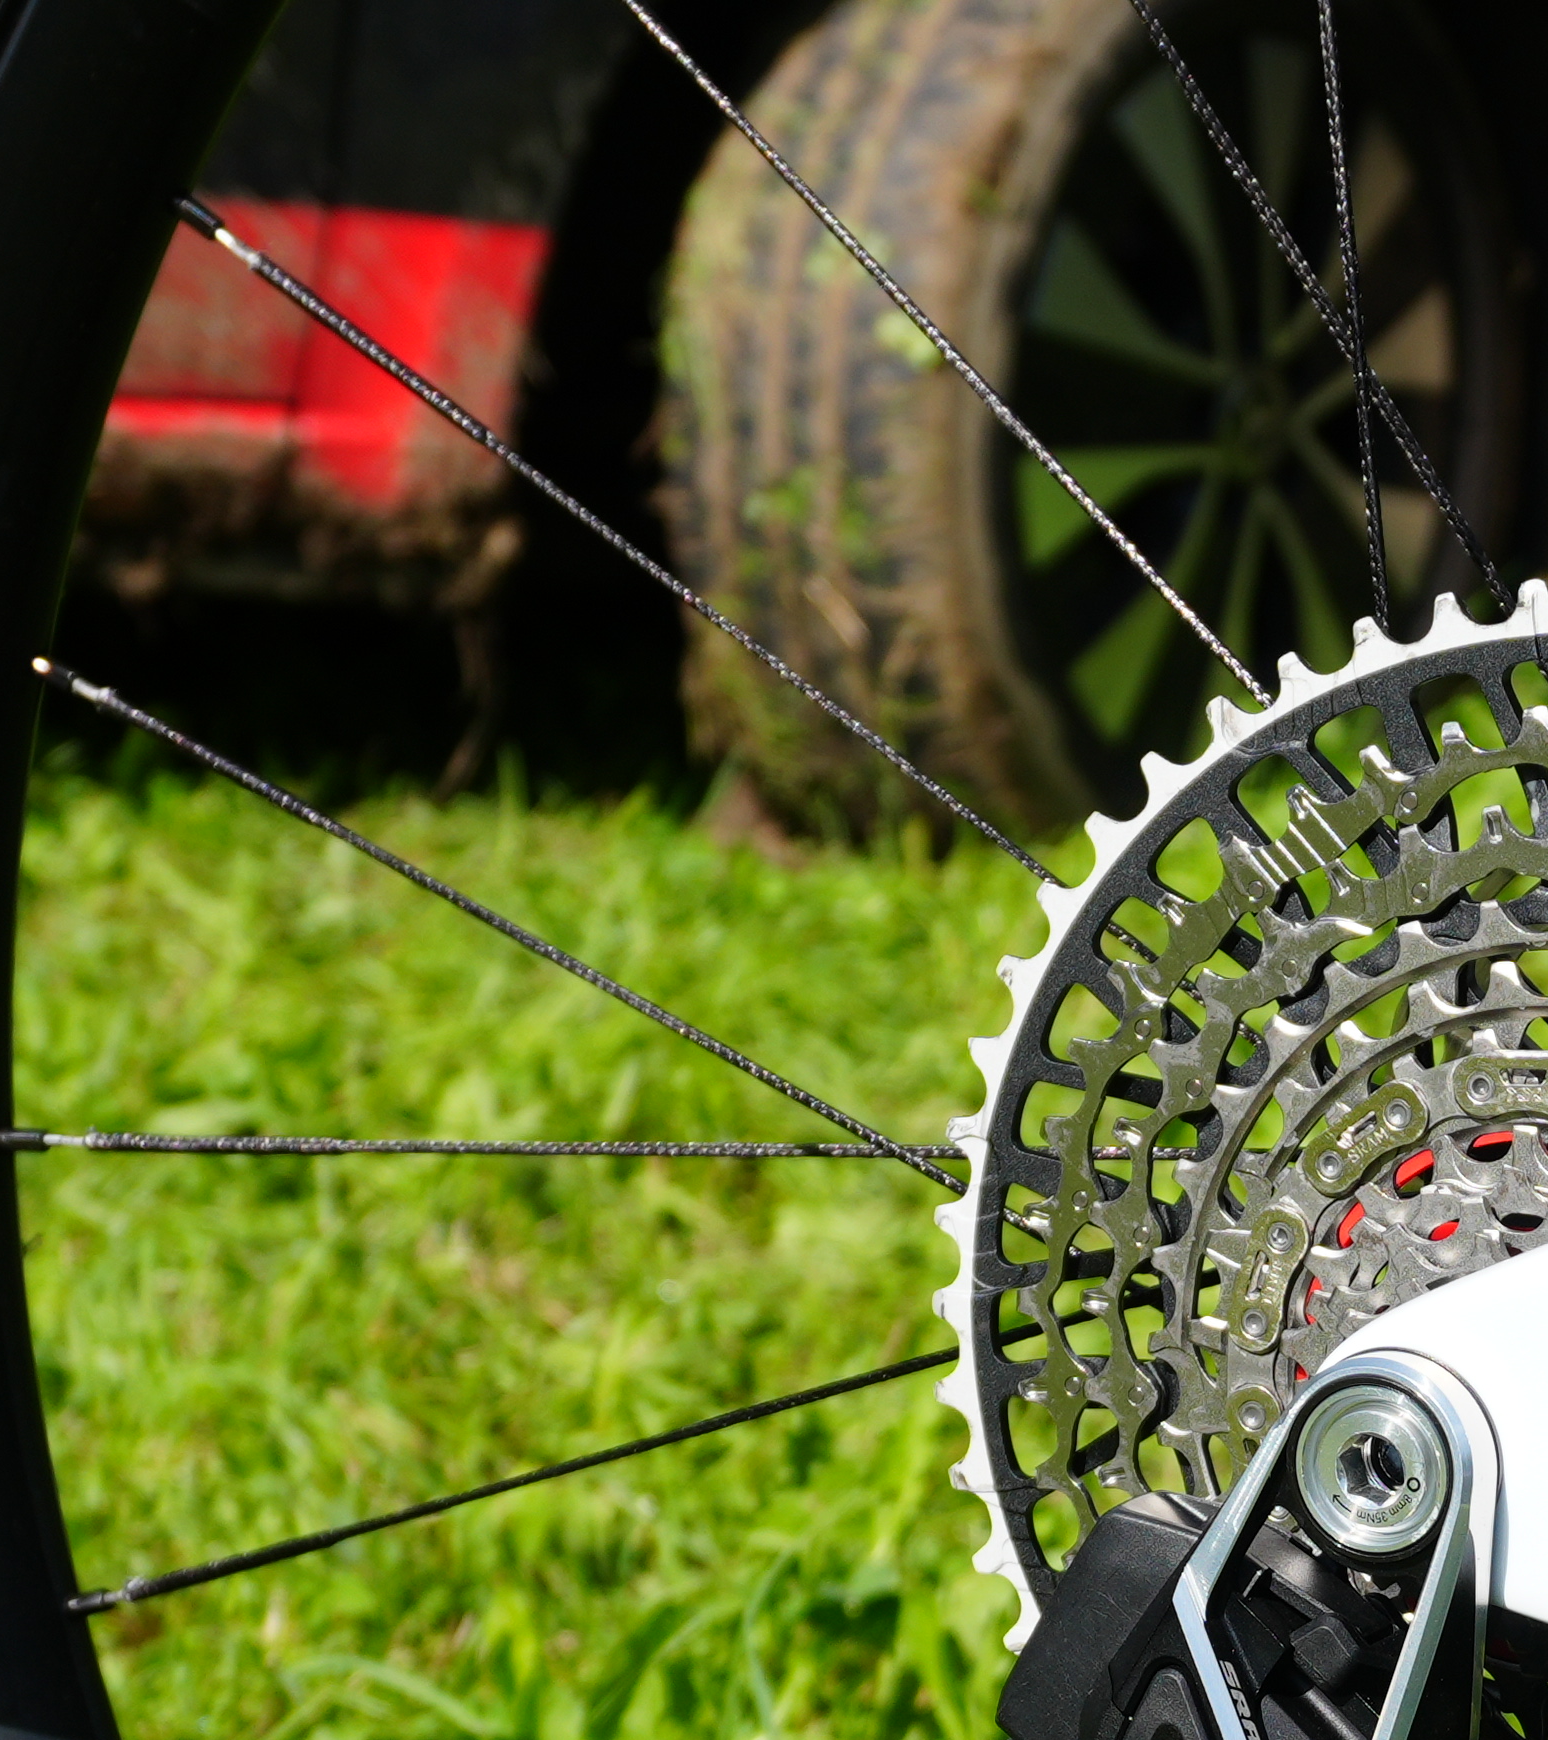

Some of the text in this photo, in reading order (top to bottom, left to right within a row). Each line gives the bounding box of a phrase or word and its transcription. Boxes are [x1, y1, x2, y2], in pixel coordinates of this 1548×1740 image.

[1347, 1126, 1391, 1164] SRAM
[1354, 1493, 1413, 1524] 8mm 35Nm
